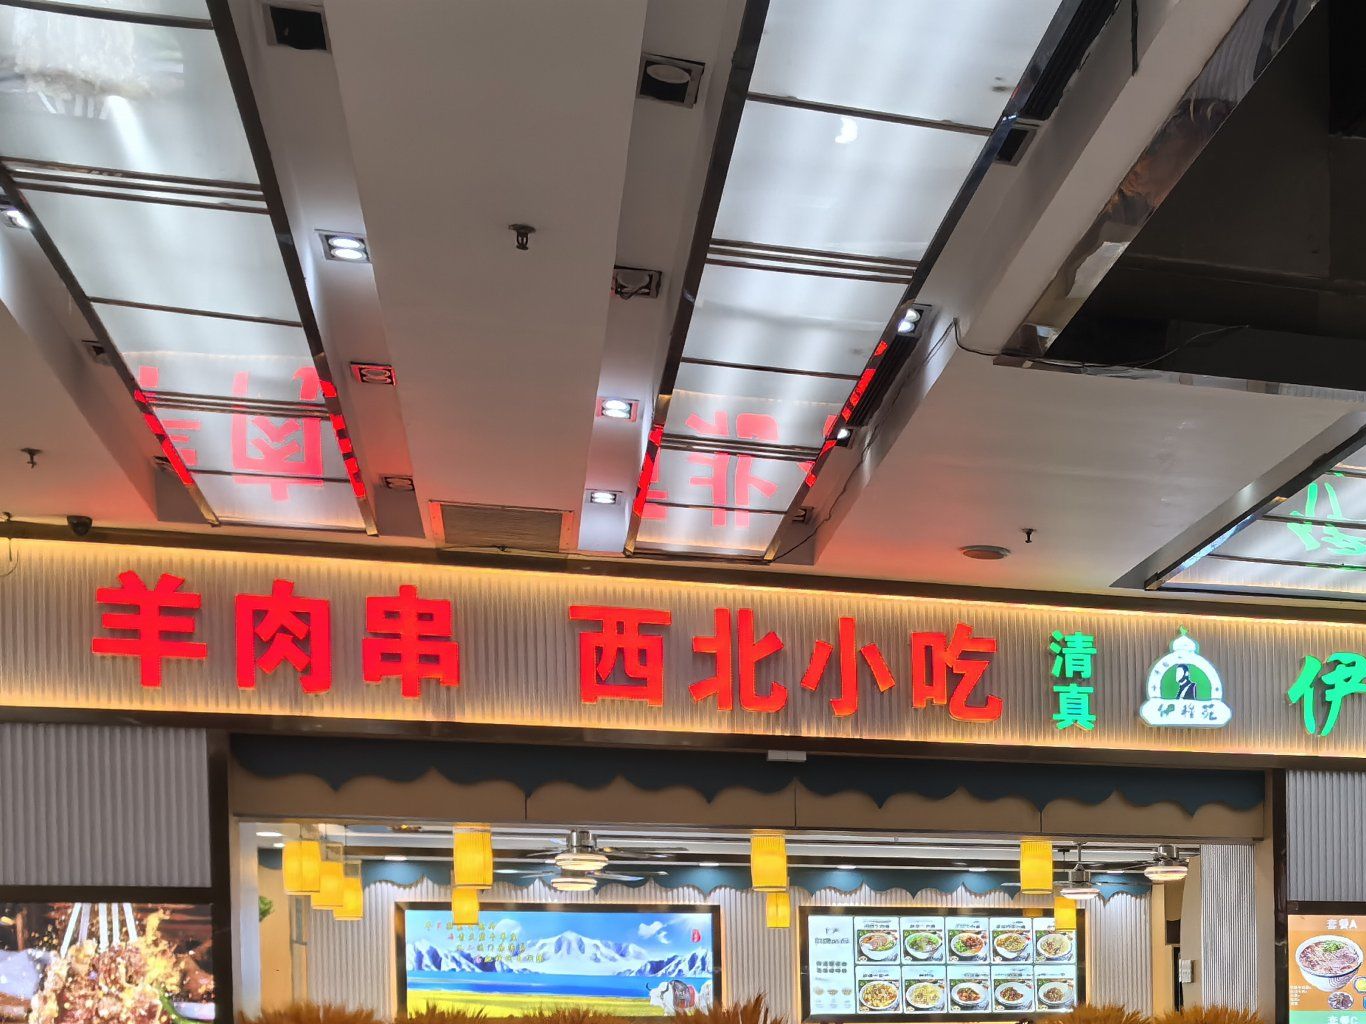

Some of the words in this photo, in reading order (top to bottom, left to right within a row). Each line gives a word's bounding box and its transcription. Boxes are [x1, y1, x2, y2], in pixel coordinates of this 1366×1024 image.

[92, 570, 460, 698] 羊肉串
[568, 605, 1004, 723] 西北小吃
[1049, 630, 1098, 732] 清真
[1326, 918, 1358, 930] 套餐A
